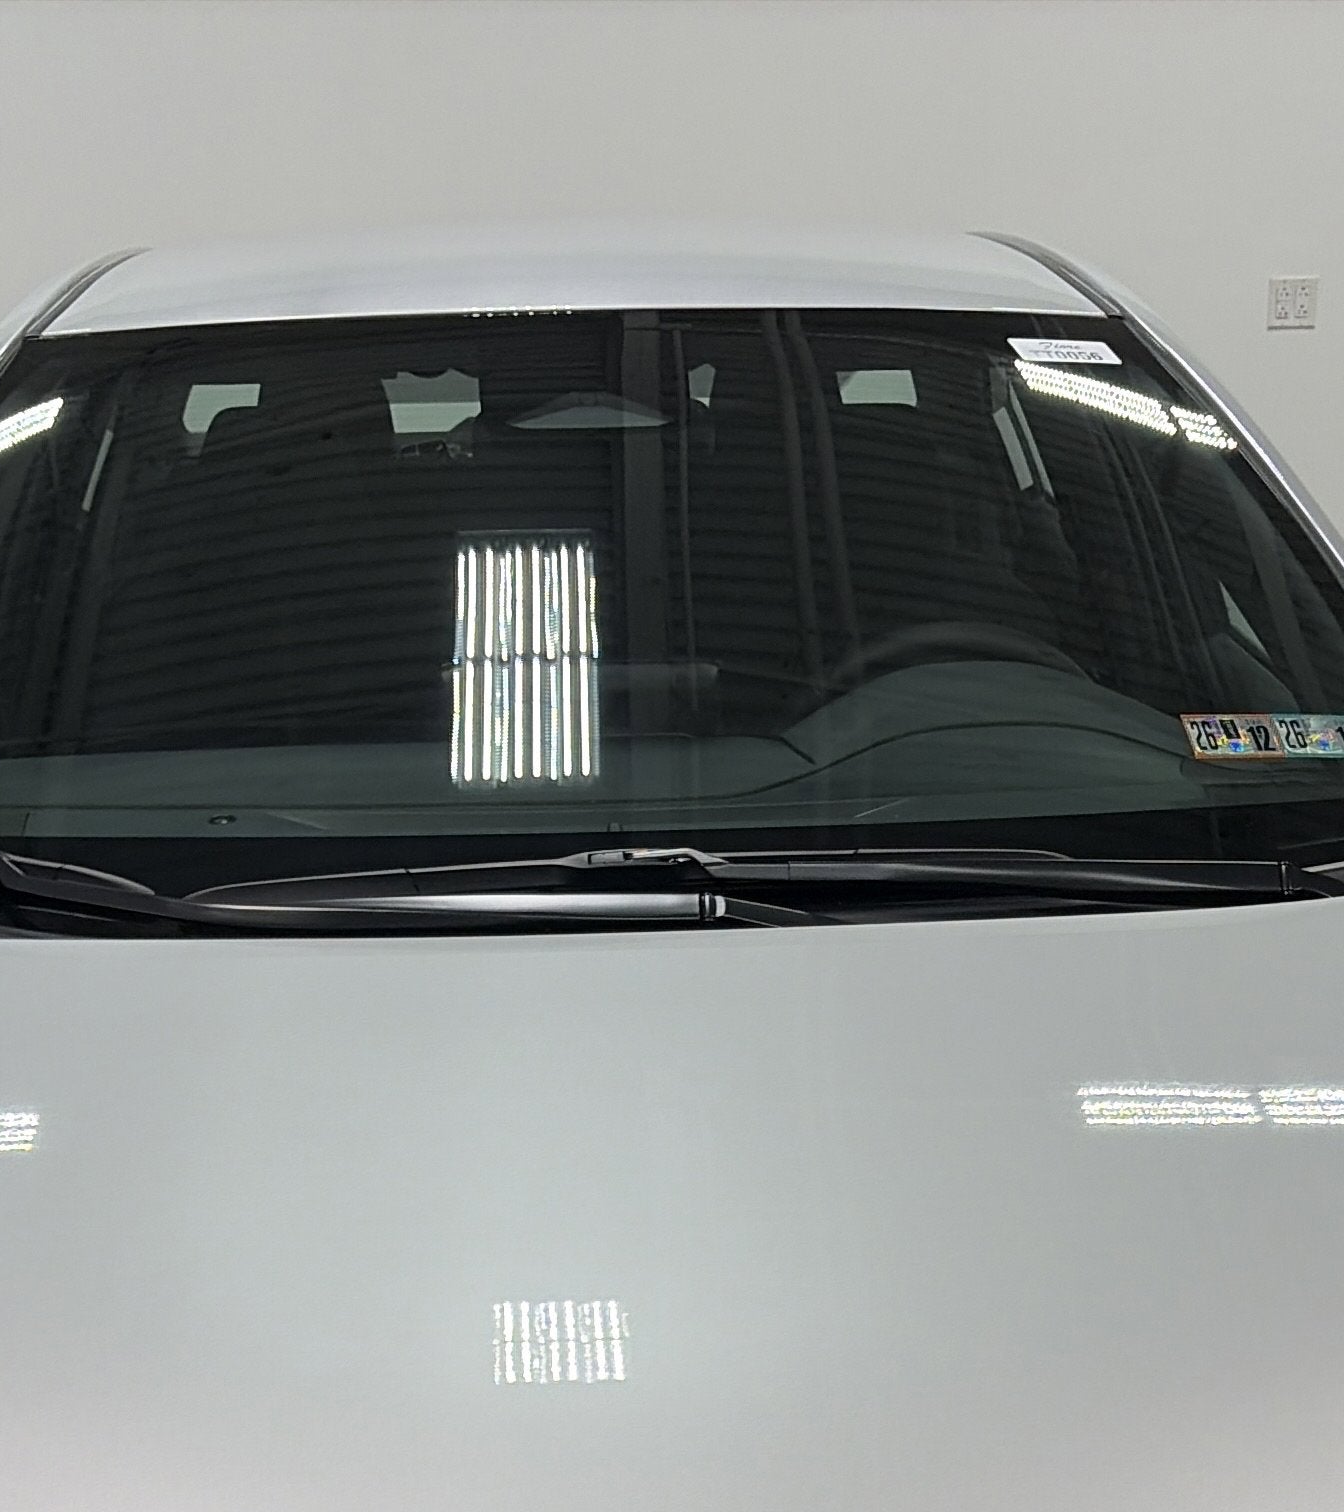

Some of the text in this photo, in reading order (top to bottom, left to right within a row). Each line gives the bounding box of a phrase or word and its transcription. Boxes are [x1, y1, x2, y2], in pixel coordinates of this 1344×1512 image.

[1190, 720, 1276, 751] 26 12
[1279, 719, 1307, 749] 26
